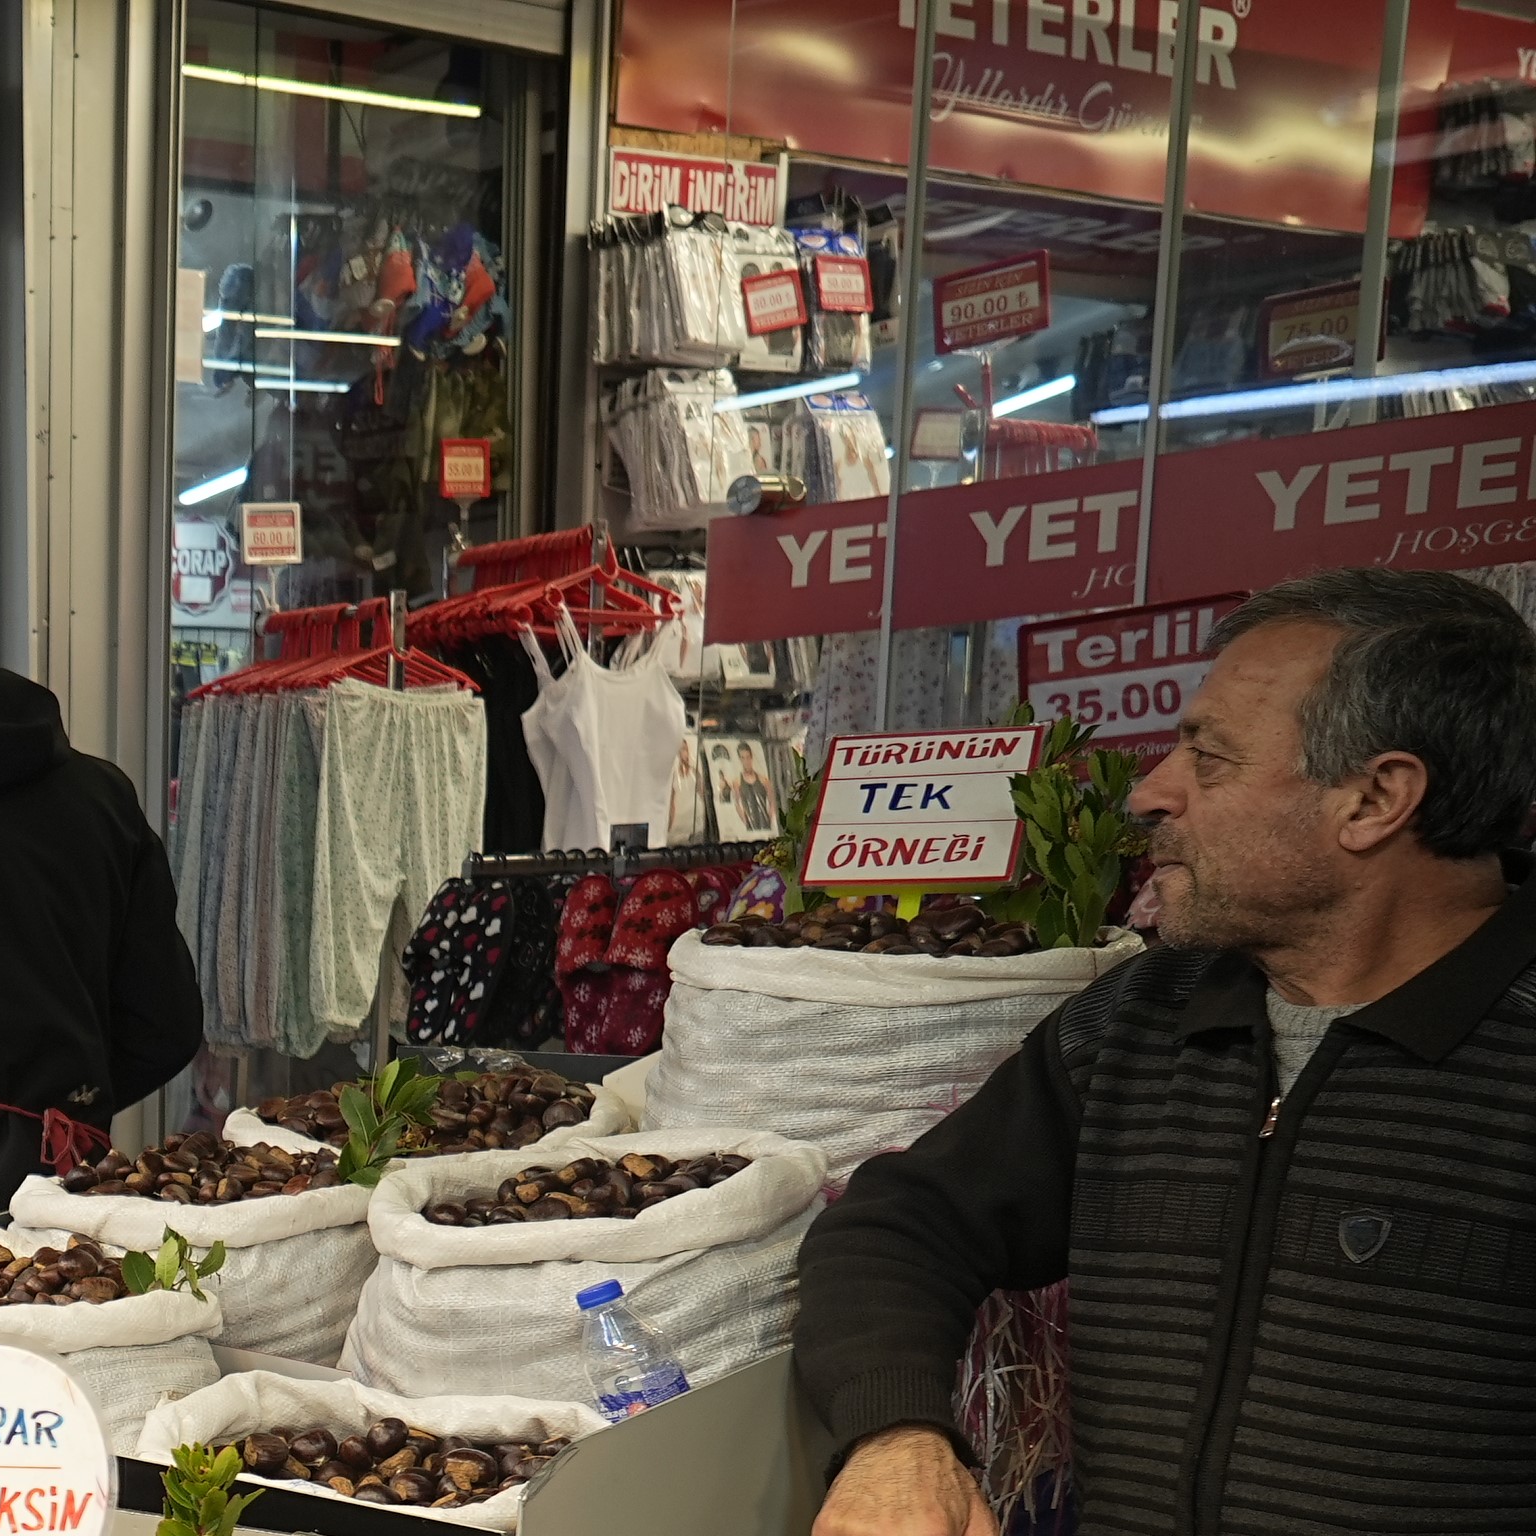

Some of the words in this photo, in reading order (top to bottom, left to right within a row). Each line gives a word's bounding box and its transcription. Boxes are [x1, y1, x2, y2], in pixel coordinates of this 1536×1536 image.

[950, 296, 1009, 323] 90.00
[1256, 436, 1536, 532] YETE
[777, 523, 888, 588] YE
[1047, 679, 1182, 726] 35.00
[837, 737, 1021, 767] TÜRÜNÜN
[860, 783, 953, 813] TEK
[827, 834, 986, 869] ÖRNEĞİ
